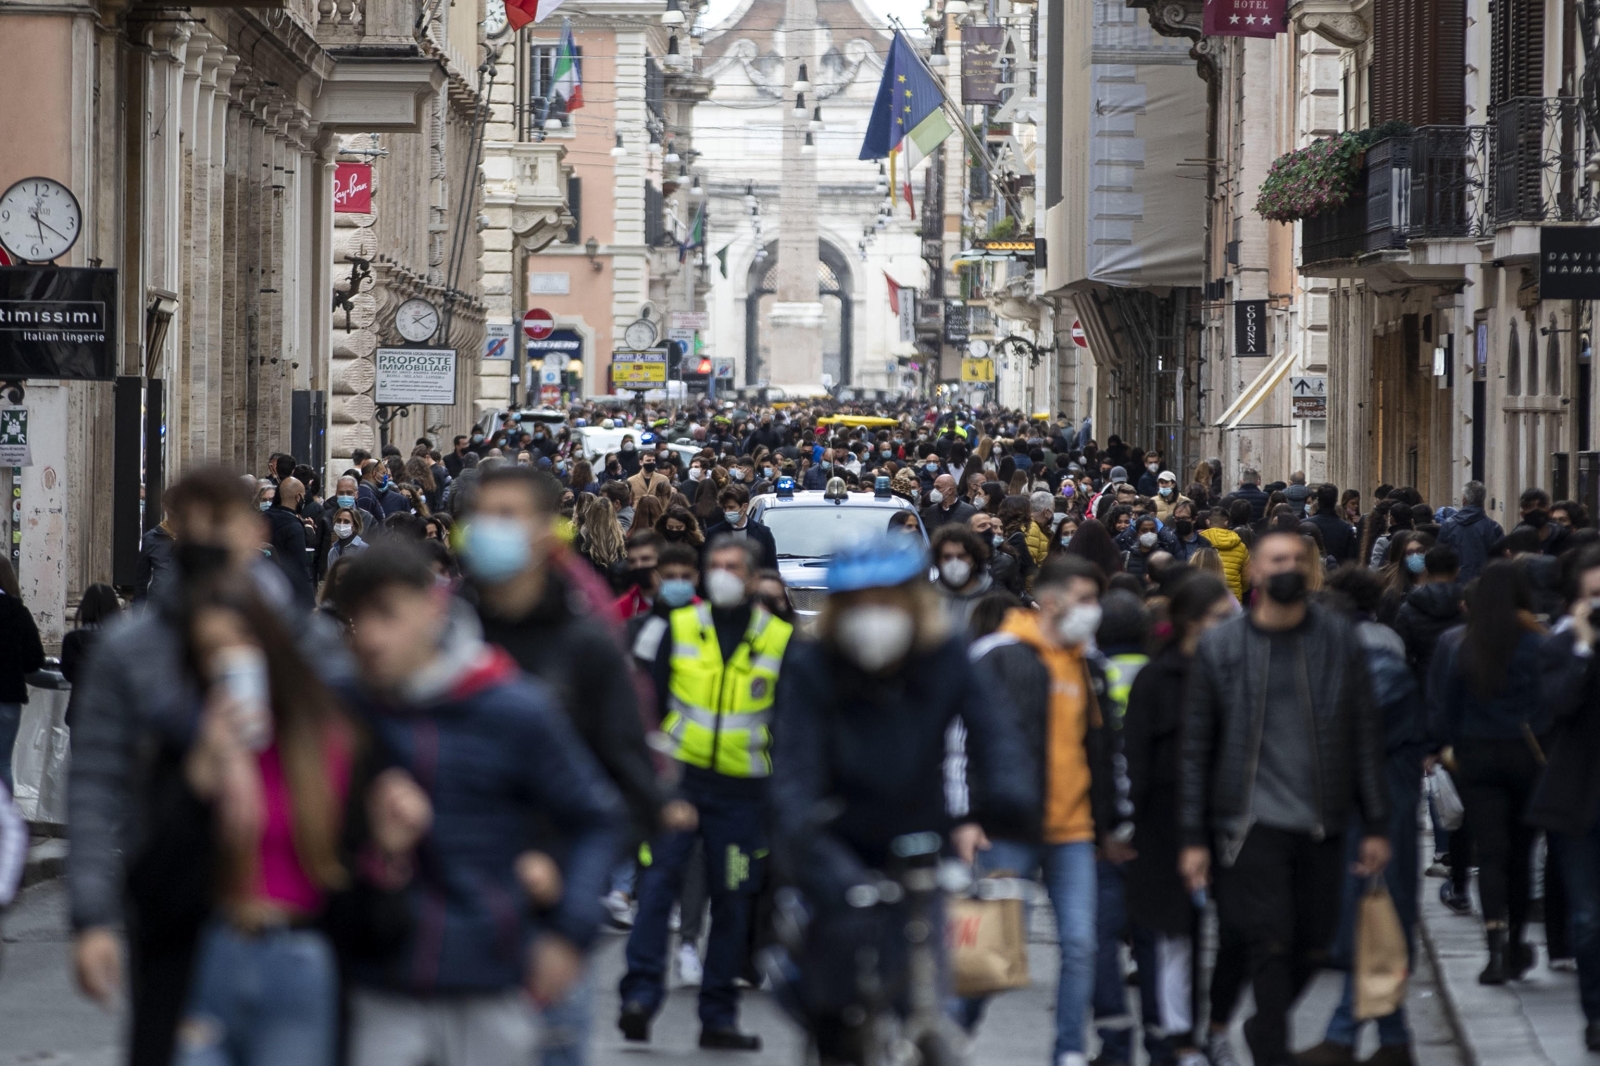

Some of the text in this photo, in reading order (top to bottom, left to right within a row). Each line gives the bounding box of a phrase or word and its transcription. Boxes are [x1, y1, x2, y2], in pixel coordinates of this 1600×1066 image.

[1234, 0, 1269, 9] HOTEL
[35, 183, 50, 198] 12
[1, 210, 11, 223] 9
[65, 216, 75, 231] 3
[30, 244, 39, 257] 6
[1246, 304, 1257, 352] COLONNA
[23, 331, 105, 343] Italian lingerie
[379, 356, 451, 365] PROPOSTE
[379, 364, 451, 372] IMMOBILIARI
